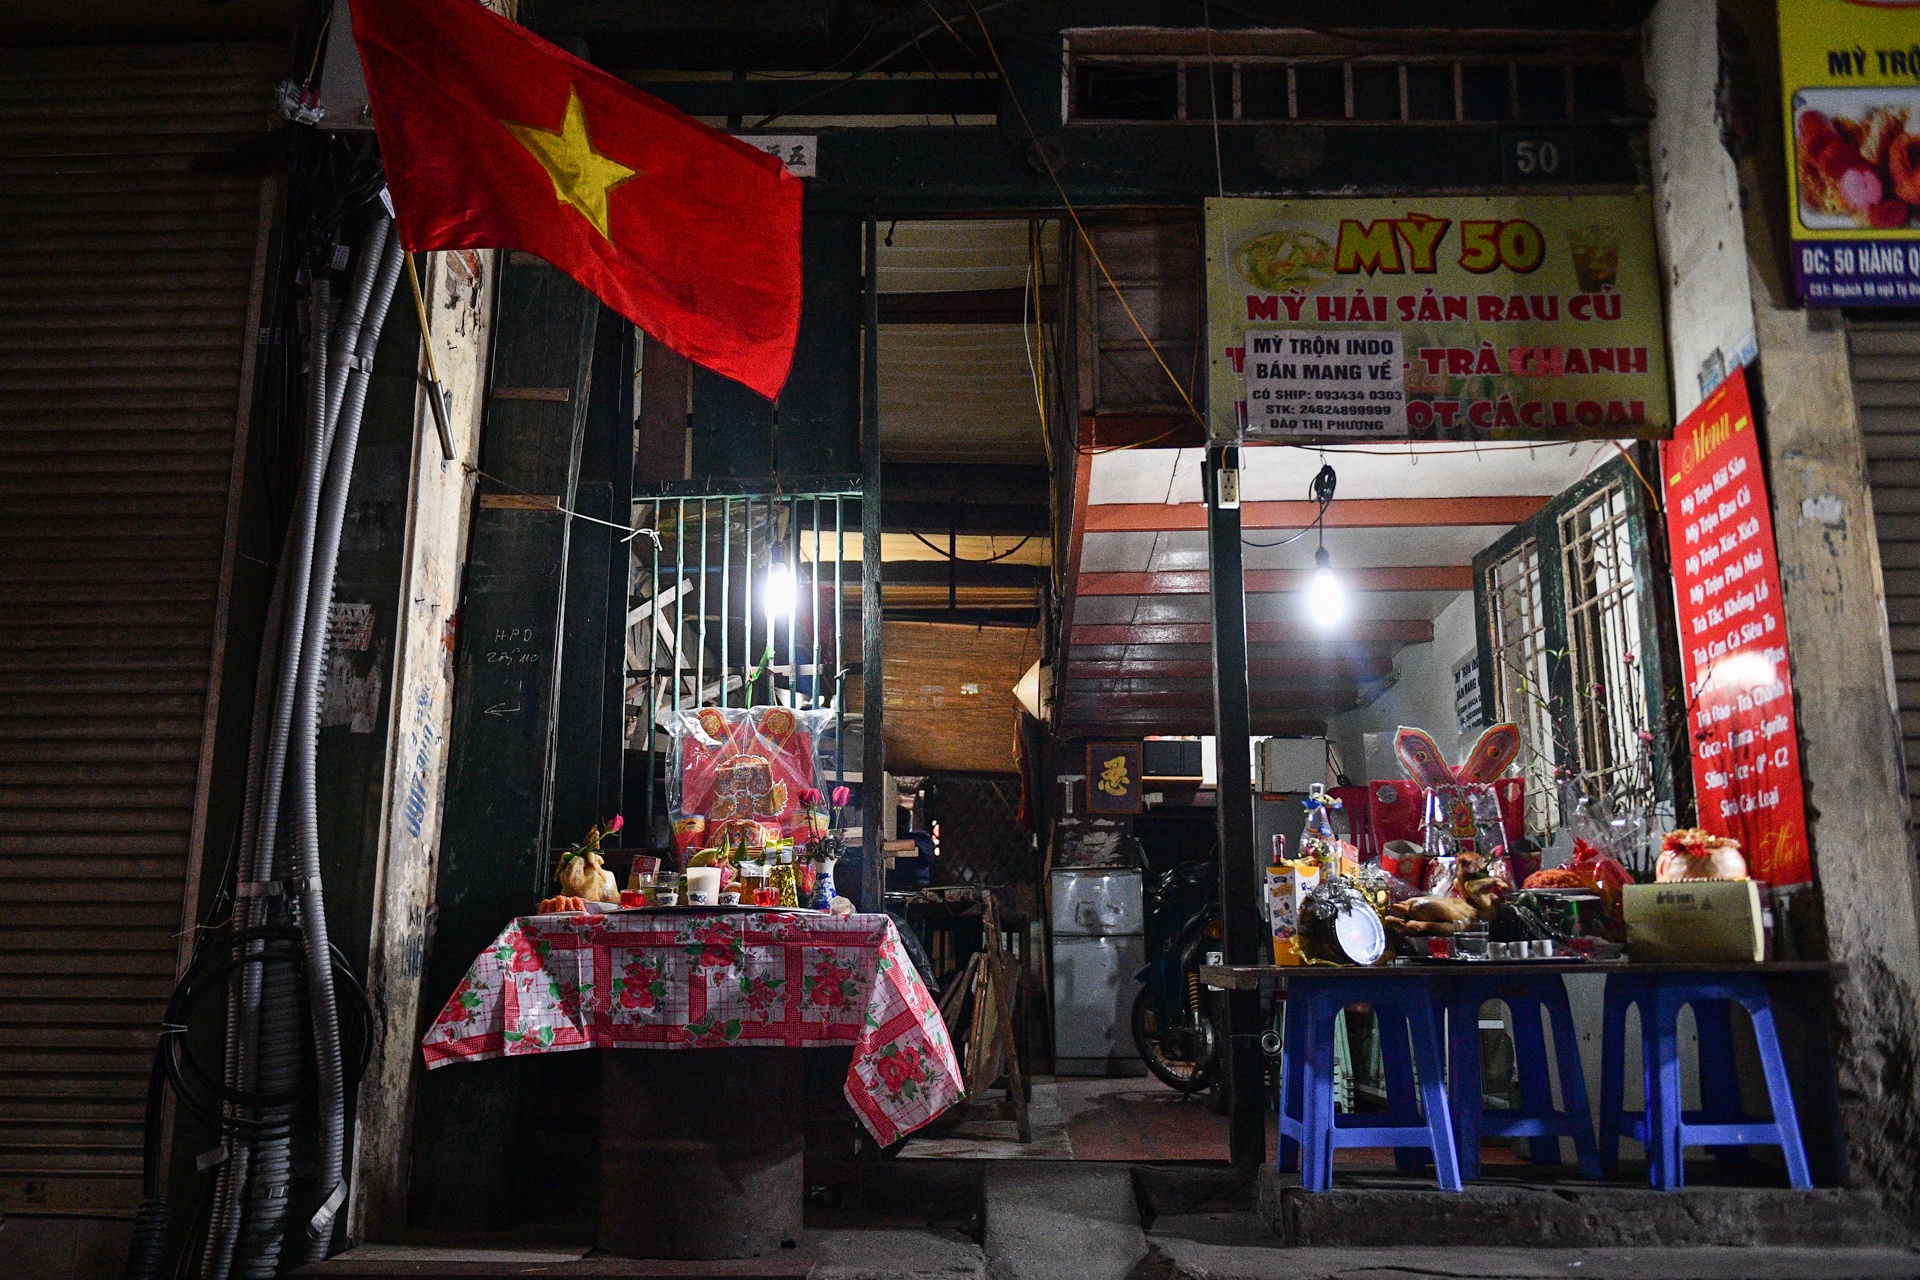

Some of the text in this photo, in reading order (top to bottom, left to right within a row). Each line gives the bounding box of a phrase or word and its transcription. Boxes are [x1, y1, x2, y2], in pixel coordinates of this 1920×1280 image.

[1827, 45, 1866, 76] MỲ
[1517, 141, 1559, 173] 50
[1333, 211, 1546, 275] MỲ 50
[1833, 247, 1855, 275] 50
[1858, 241, 1904, 274] HÀNG
[1908, 247, 1920, 277] Q
[1246, 284, 1622, 322] MỲ HẢI SẢN RAU CỦ
[1253, 333, 1393, 358] MỲ TRỘN INDO
[1420, 340, 1649, 375] TRÀ CHANH
[1256, 360, 1296, 380] BÁN
[1302, 364, 1362, 381] MANG
[1367, 359, 1392, 381] VỀ
[1252, 388, 1403, 401] CÓ SHIP: 093434 0303
[1265, 405, 1391, 416] STK: 24624899999
[1468, 392, 1544, 429] CÁC
[1301, 420, 1323, 432] THỊ
[1327, 420, 1384, 431] PHƯƠNG
[1681, 412, 1730, 475] Menu
[1692, 614, 1708, 635] Trà
[1692, 646, 1708, 667] Trà
[1740, 621, 1763, 644] Siêu
[1762, 612, 1776, 633] To
[1696, 709, 1712, 728] Trà
[1736, 693, 1753, 713] Trà
[1699, 714, 1790, 760] Coca Fanta Sprite
[1704, 770, 1729, 790] Sting
[1774, 747, 1790, 769] C2
[1757, 785, 1780, 810] Loại
